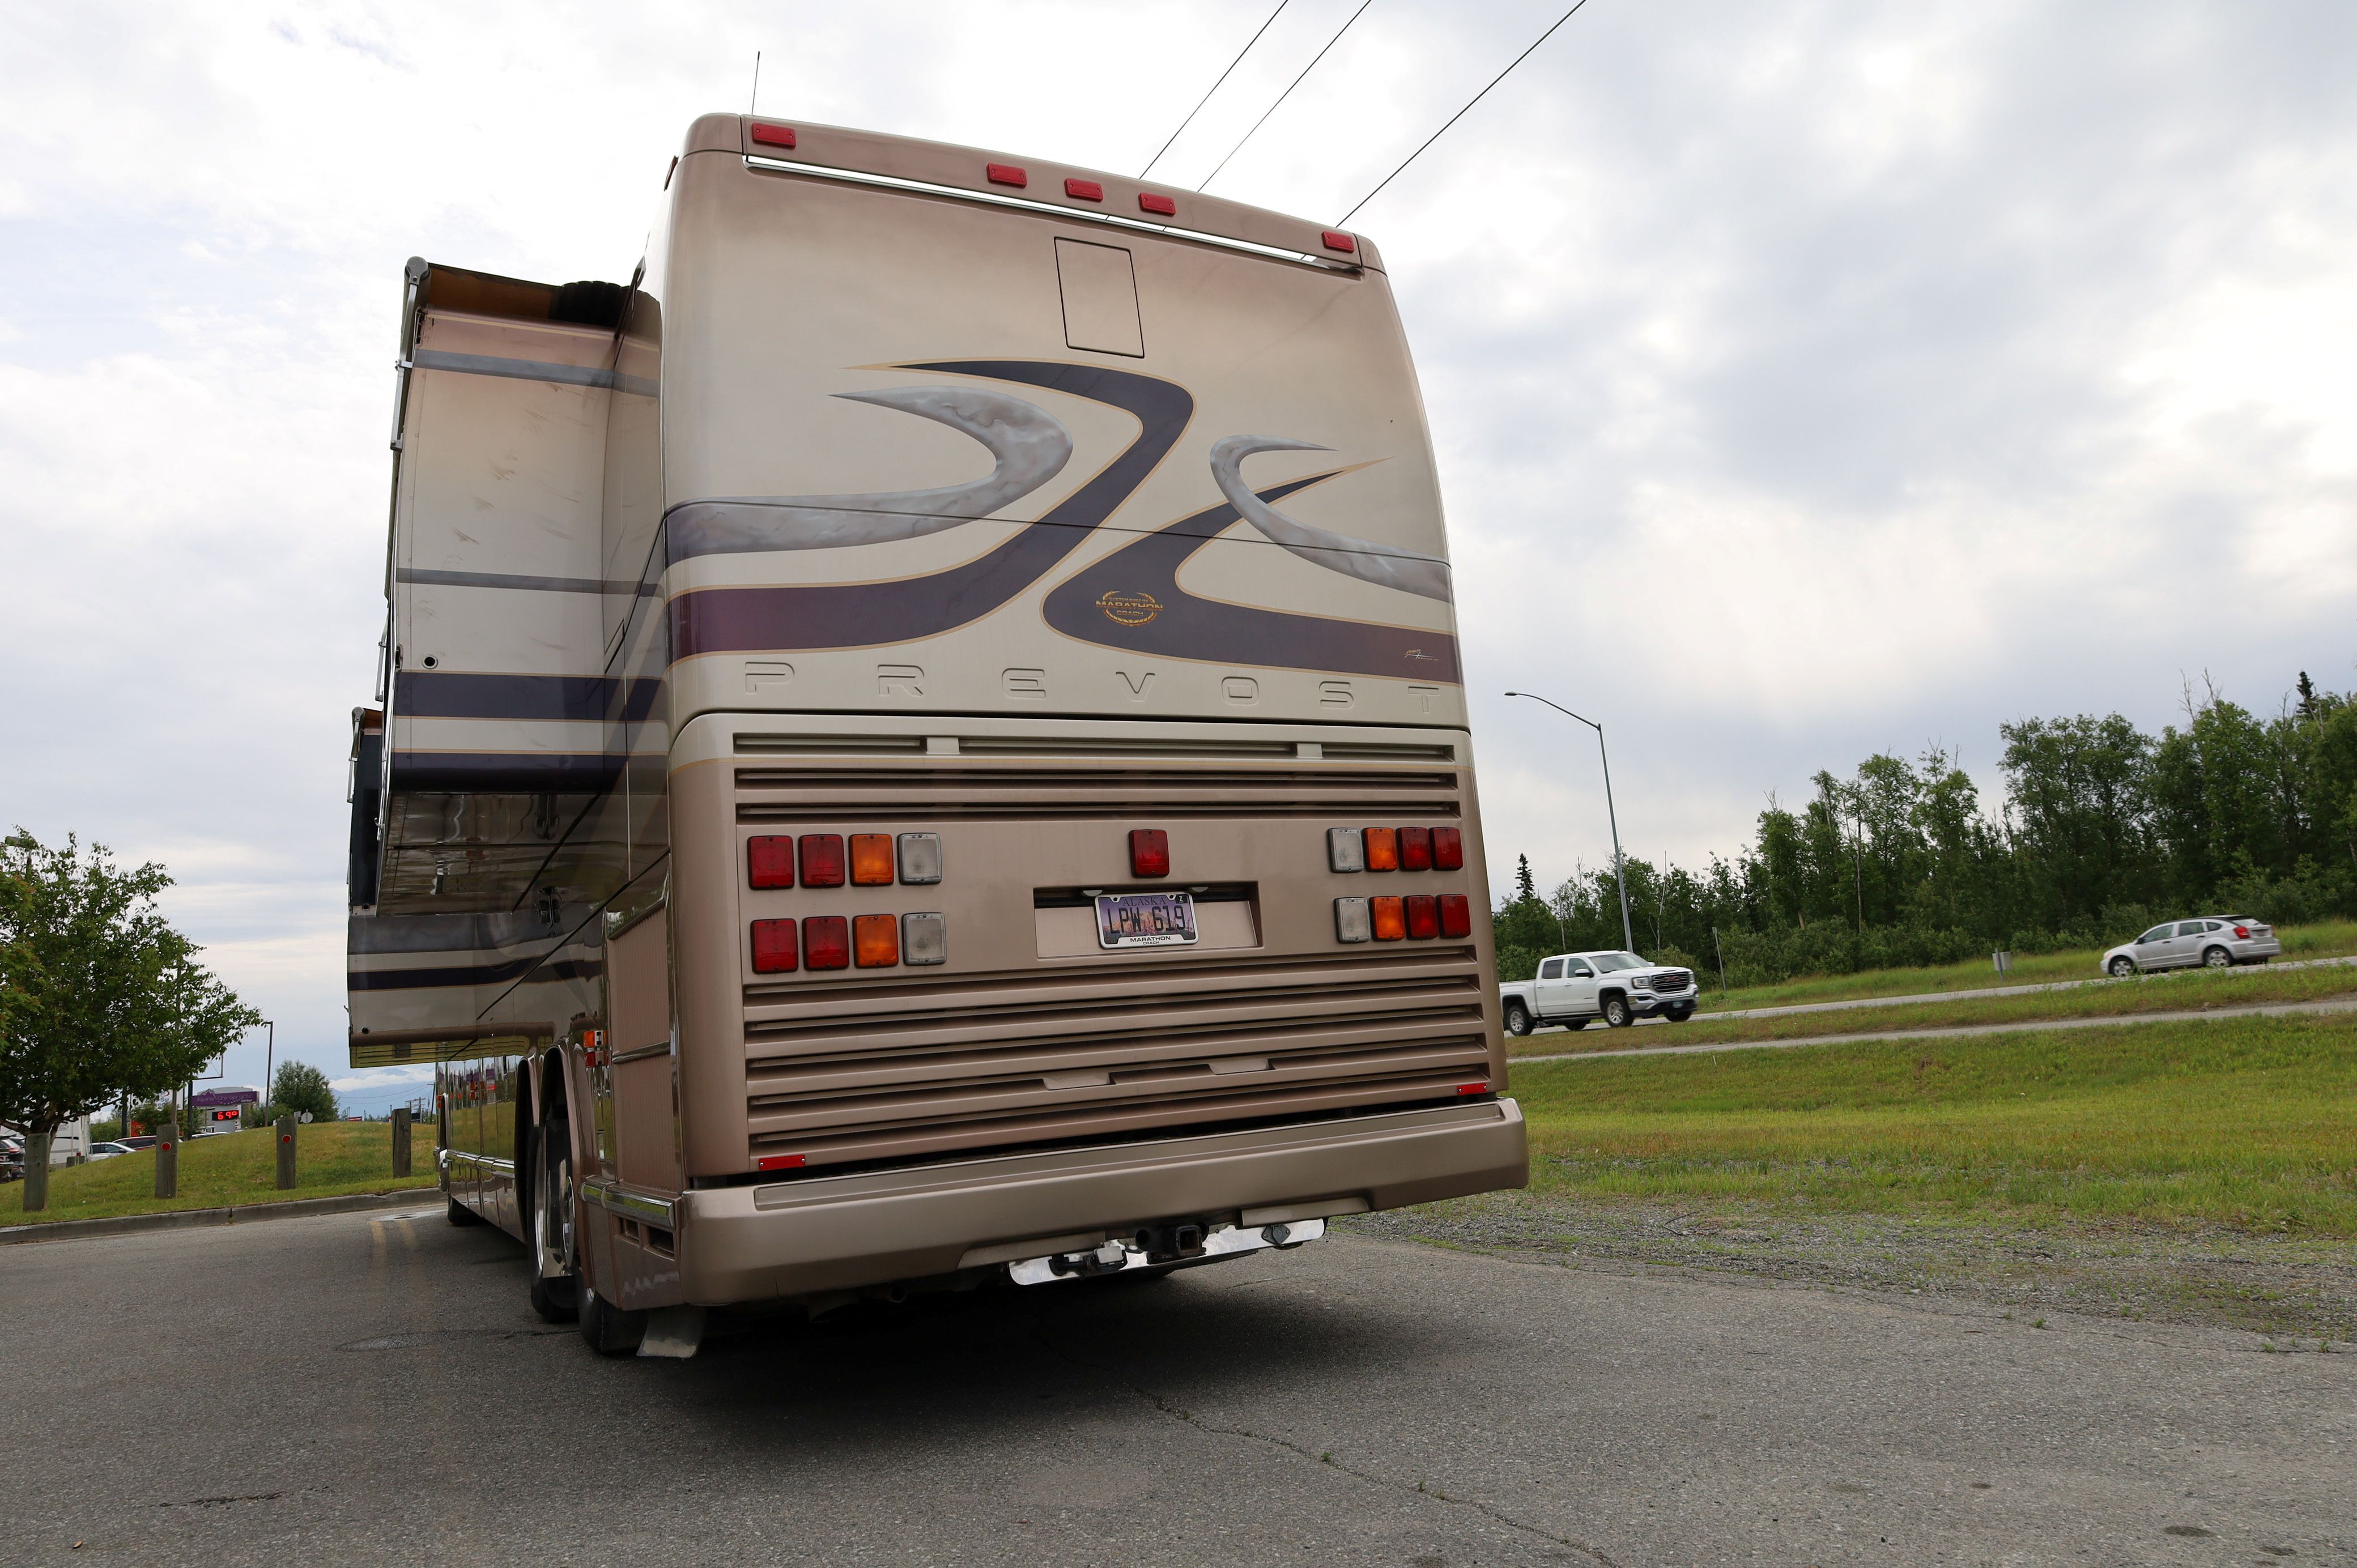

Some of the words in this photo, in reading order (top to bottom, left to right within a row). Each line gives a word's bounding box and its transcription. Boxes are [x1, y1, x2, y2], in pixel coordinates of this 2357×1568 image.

[1096, 600, 1164, 610] MARATHON
[744, 662, 1439, 714] PREVOST
[1123, 897, 1166, 906] ALASKA
[1107, 906, 1142, 934] LPW
[1152, 905, 1185, 931] 619
